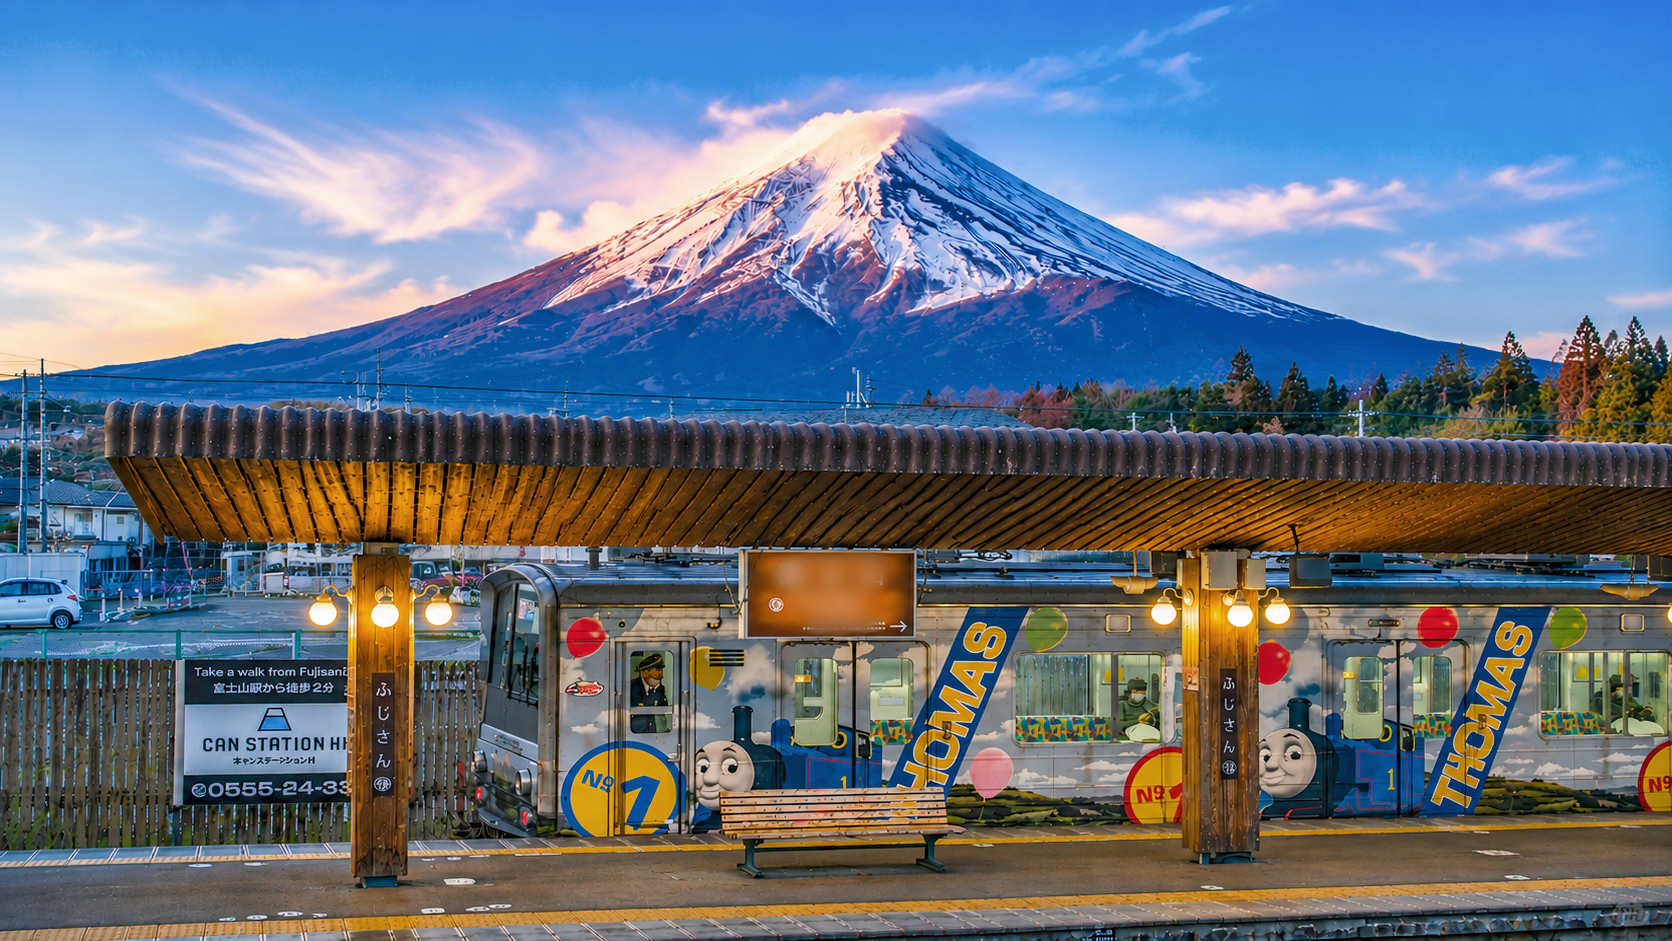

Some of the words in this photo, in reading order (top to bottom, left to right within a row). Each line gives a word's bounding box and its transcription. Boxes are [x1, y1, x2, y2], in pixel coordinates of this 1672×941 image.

[194, 667, 224, 677] Take
[227, 669, 235, 677] a
[238, 667, 265, 677] walk
[269, 667, 296, 677] from
[897, 622, 1006, 788] HOMAS
[203, 737, 239, 752] CAN
[246, 737, 324, 751] STATION
[376, 682, 391, 768] ふじさん
[1223, 676, 1235, 753] ふじさん
[1430, 621, 1533, 808] THOMAS
[621, 775, 661, 831] 1
[1387, 768, 1395, 790] 1
